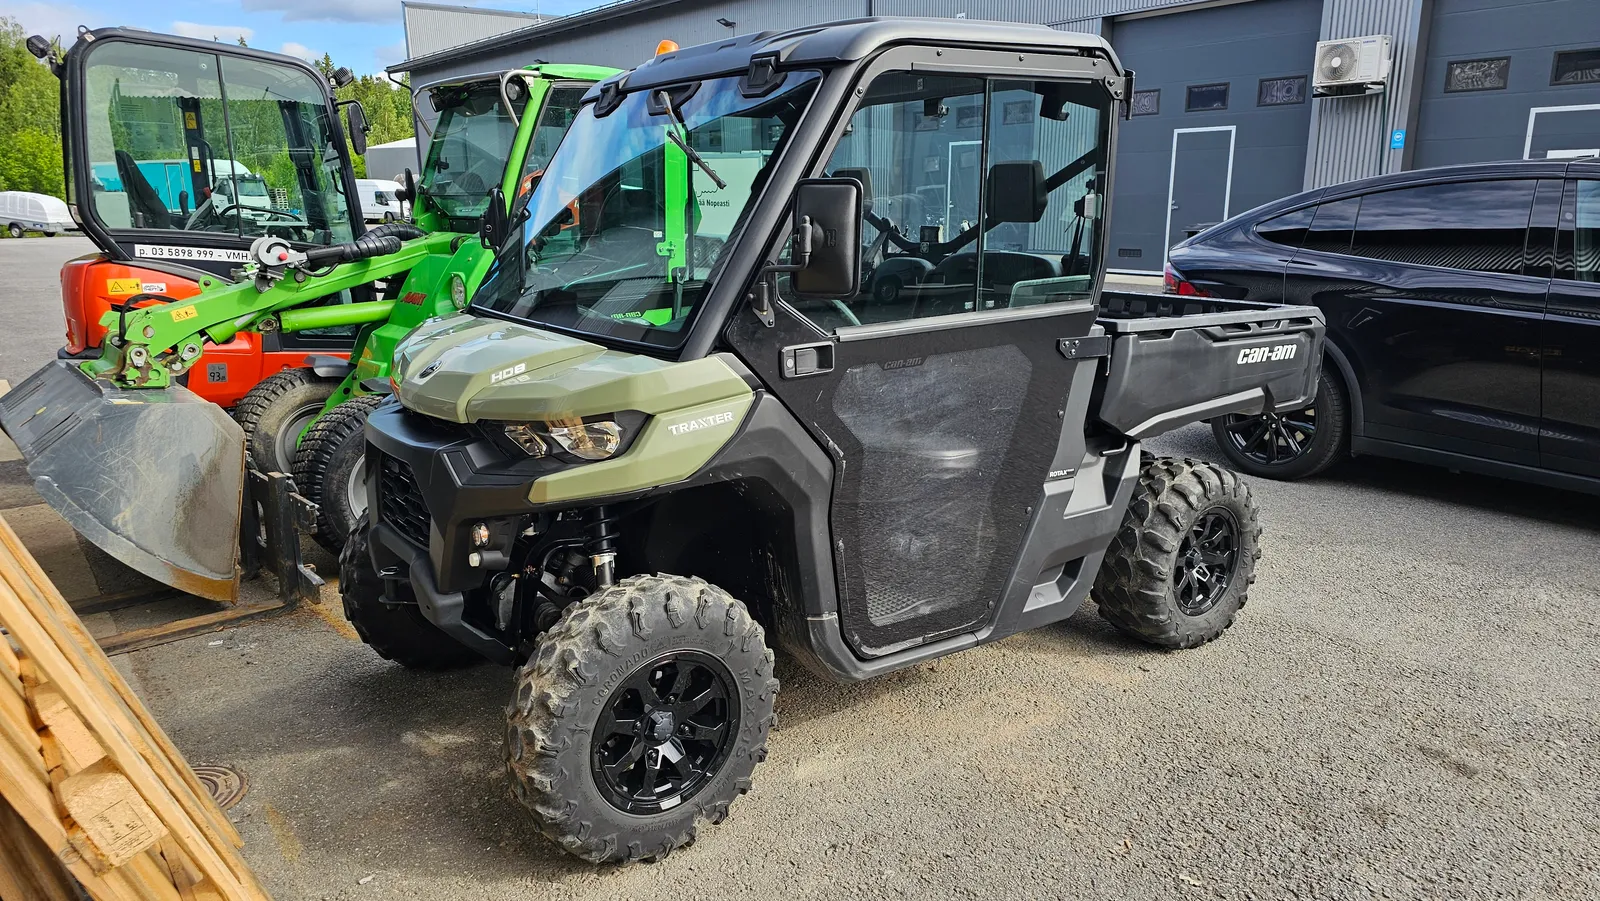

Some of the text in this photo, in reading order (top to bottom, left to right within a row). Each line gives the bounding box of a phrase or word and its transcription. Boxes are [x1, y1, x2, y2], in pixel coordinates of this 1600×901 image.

[706, 199, 730, 208] Nopeasti
[139, 248, 148, 256] p.
[151, 247, 164, 256] 03
[167, 248, 193, 257] 5898
[196, 249, 214, 258] 999
[1236, 344, 1297, 365] can-am
[883, 357, 921, 369] can-am
[209, 371, 220, 381] 93
[667, 411, 733, 435] TRAXTER
[1049, 469, 1068, 478] ROTAX
[737, 668, 756, 758] MAXXIS
